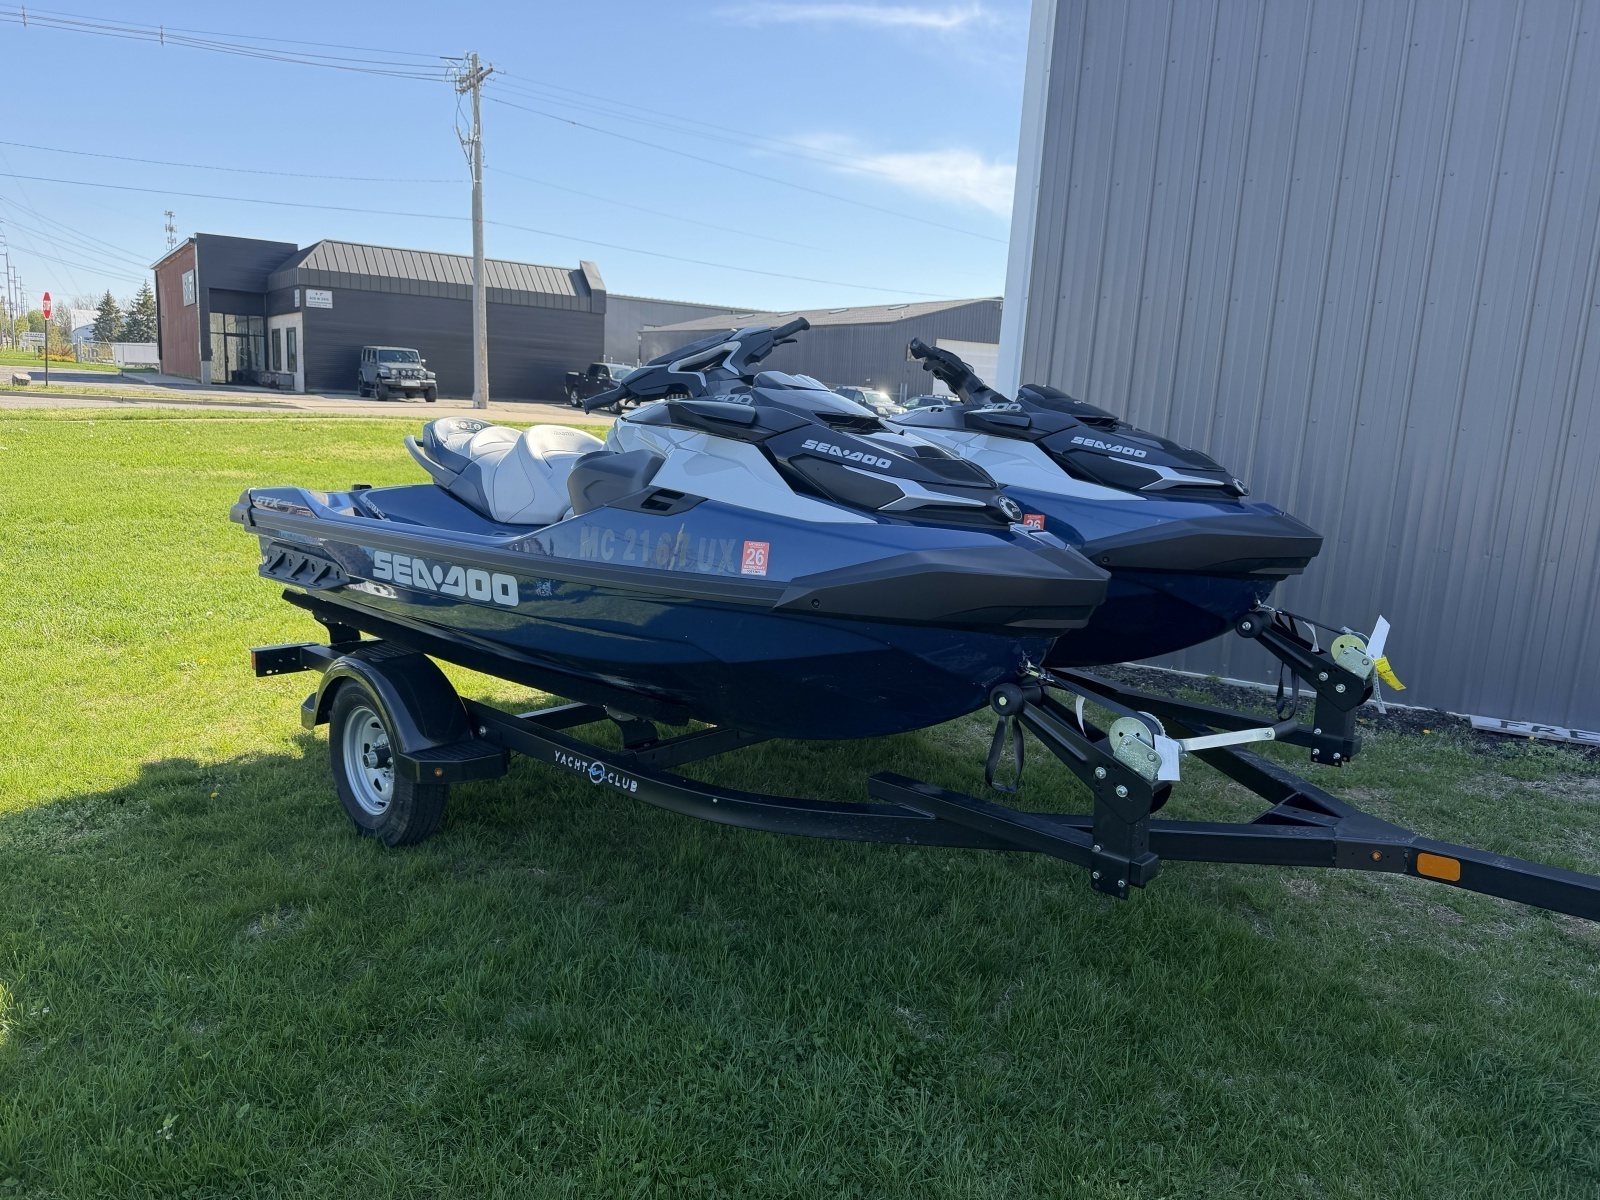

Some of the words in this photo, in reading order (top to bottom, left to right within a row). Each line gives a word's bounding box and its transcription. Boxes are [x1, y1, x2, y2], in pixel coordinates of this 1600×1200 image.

[1026, 519, 1041, 529] 26
[579, 526, 615, 561] MC
[697, 538, 737, 572] UX
[745, 548, 765, 566] 26
[554, 750, 588, 773] YACHT
[607, 772, 638, 793] CLUB
